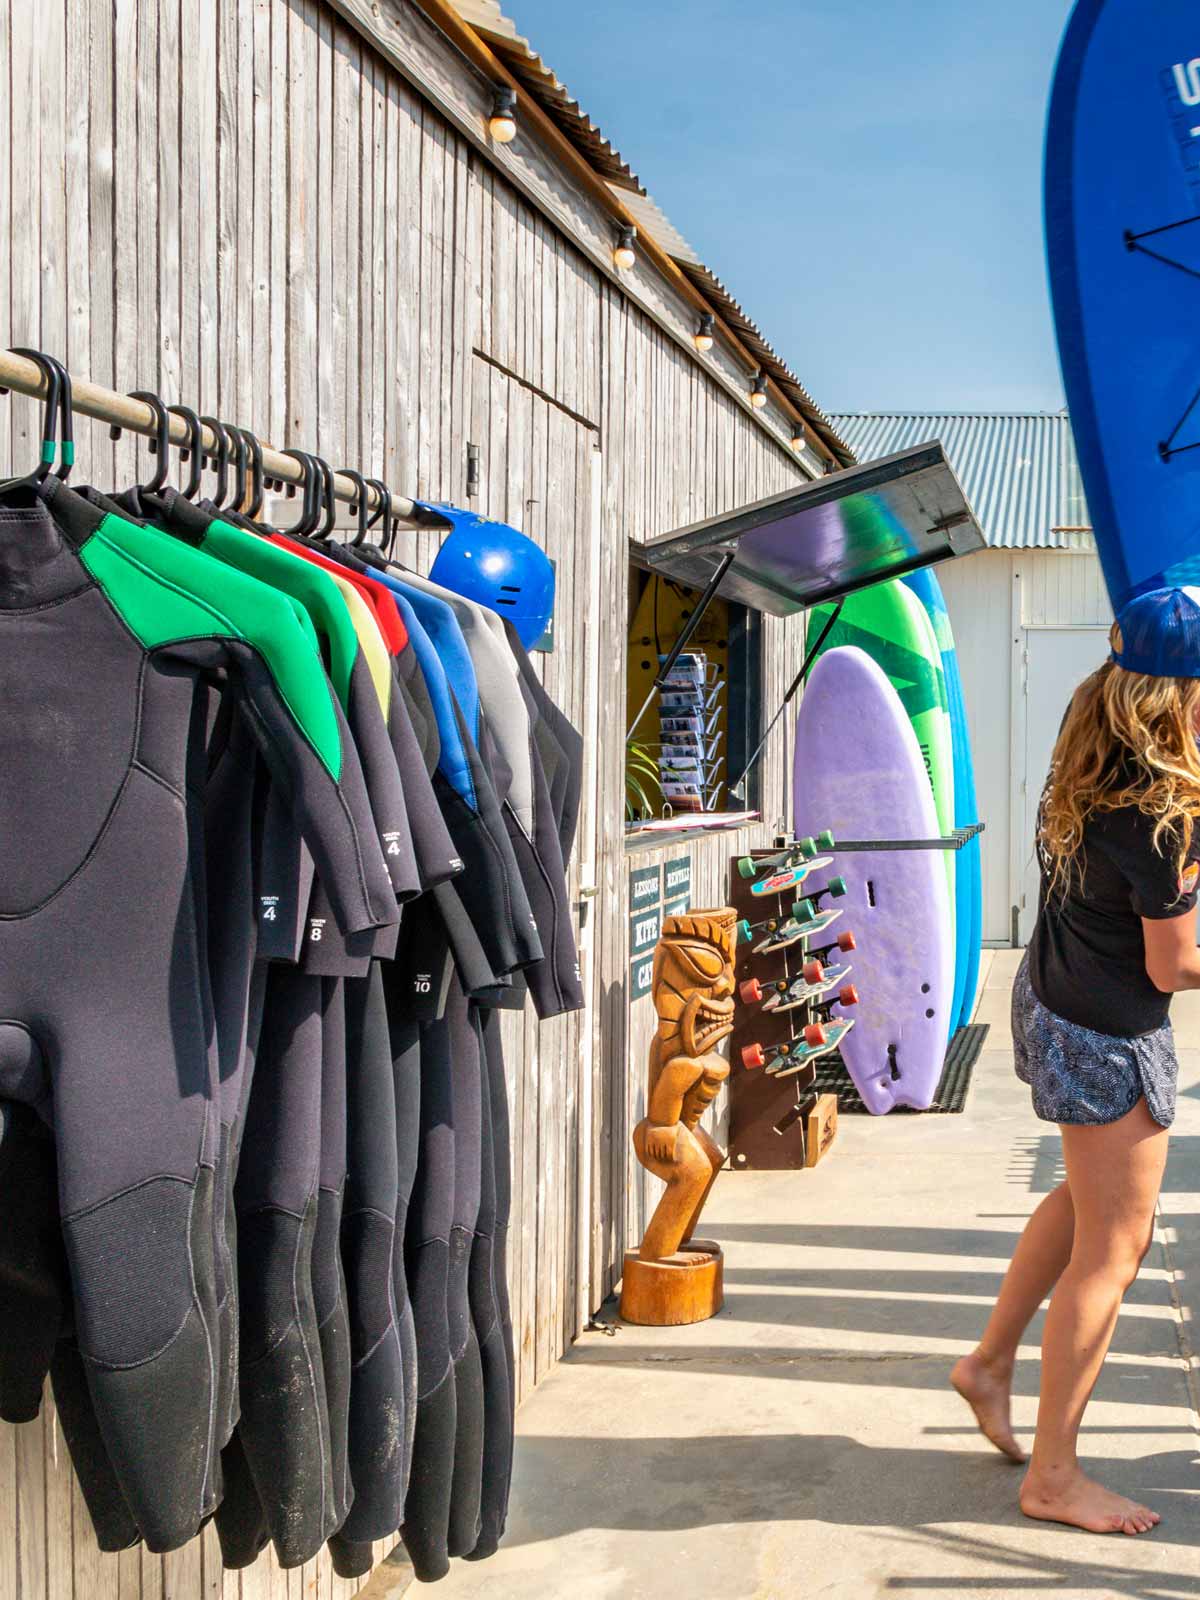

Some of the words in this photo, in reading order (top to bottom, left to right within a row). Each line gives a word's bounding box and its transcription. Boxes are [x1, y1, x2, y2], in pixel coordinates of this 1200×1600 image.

[387, 841, 400, 856] 4
[263, 906, 277, 921] 4
[310, 928, 322, 941] 8
[635, 916, 658, 947] KITE
[414, 981, 431, 993] 10
